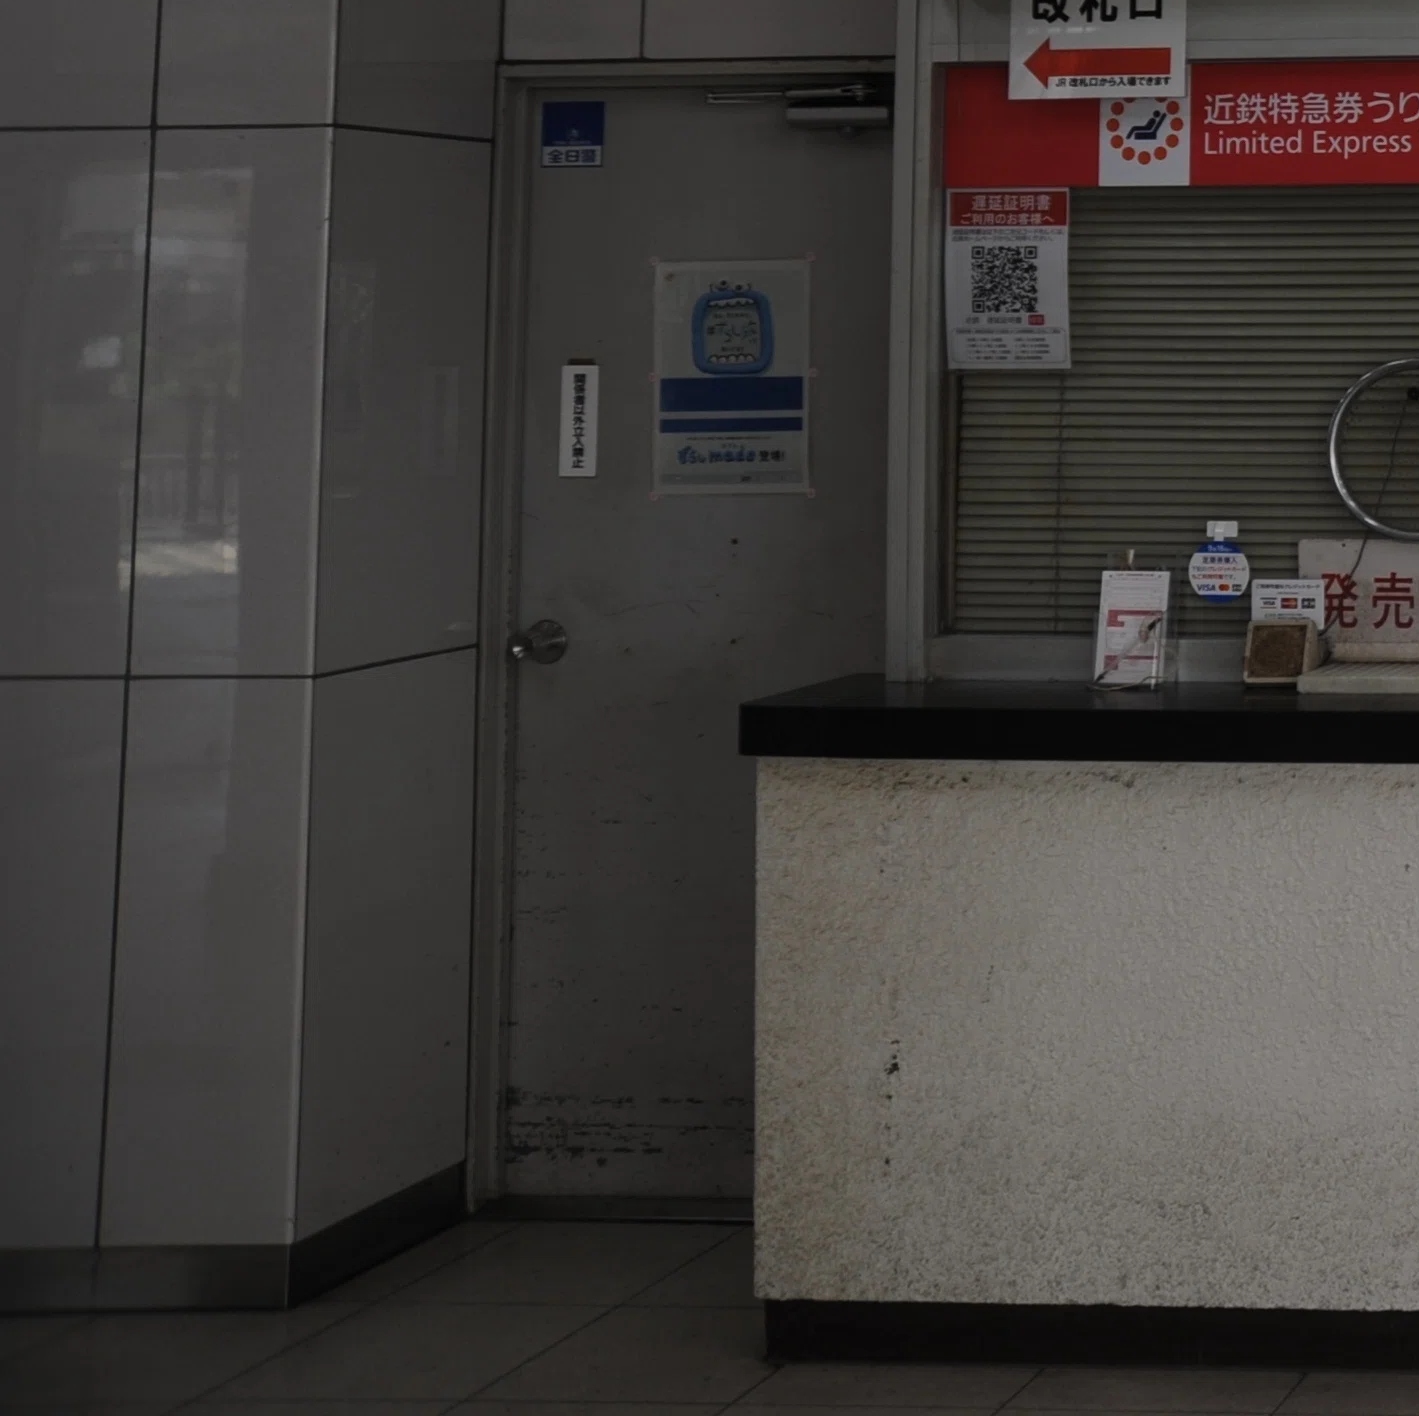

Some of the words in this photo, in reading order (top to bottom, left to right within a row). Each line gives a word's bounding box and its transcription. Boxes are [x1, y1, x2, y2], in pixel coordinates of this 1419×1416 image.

[1056, 77, 1067, 88] JR
[1204, 130, 1303, 155] Limited
[1313, 129, 1413, 160] Express
[971, 194, 1052, 212] 遅延証明書
[960, 212, 1055, 225] ご利用のお客様へ
[1197, 583, 1216, 592] VISA
